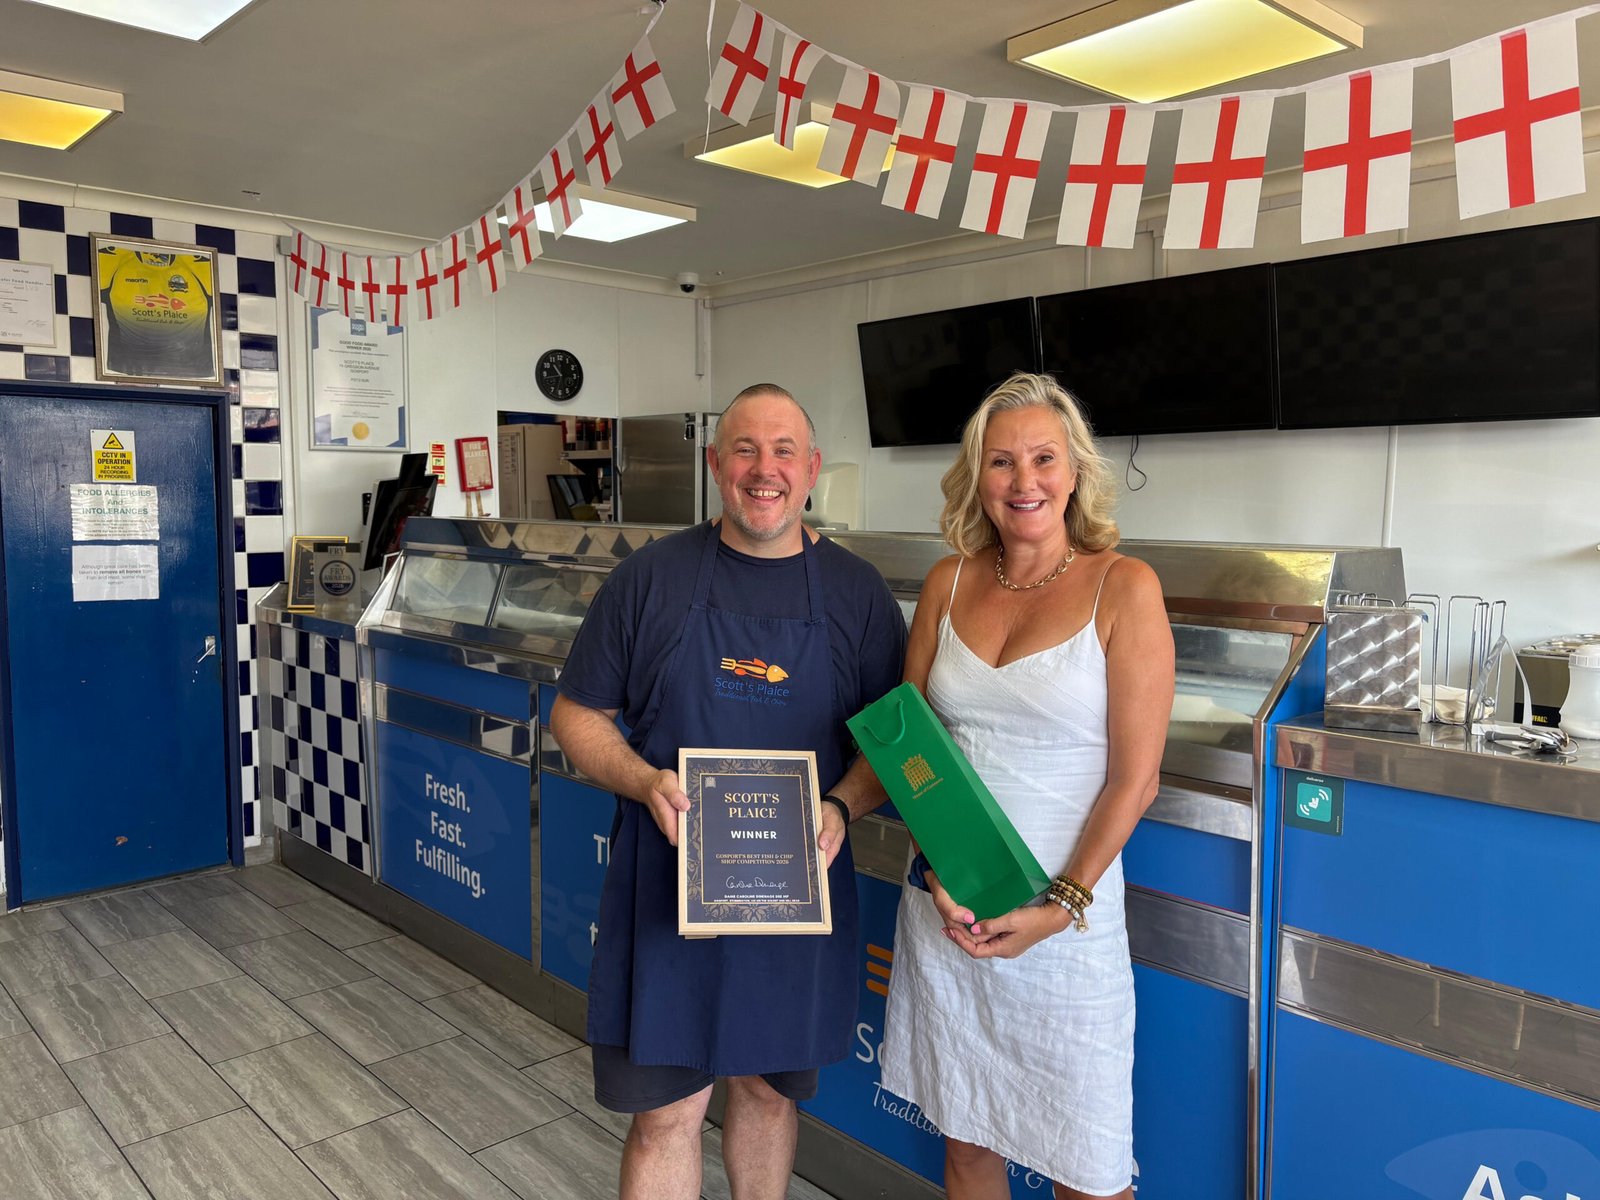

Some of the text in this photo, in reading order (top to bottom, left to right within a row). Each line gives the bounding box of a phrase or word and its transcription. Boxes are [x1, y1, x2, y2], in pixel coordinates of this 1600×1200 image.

[132, 308, 188, 319] Scott's Plaice
[104, 489, 151, 497] ALLERGIES
[82, 507, 148, 515] INTOLERANCES
[714, 677, 790, 697] Scott's Plaice
[425, 772, 471, 813] Fresh.
[724, 792, 780, 804] SCOTT'S
[728, 807, 777, 819] PLAICE
[431, 811, 466, 849] Fast.
[730, 830, 777, 840] WINNER
[415, 838, 486, 899] Fulfilling.
